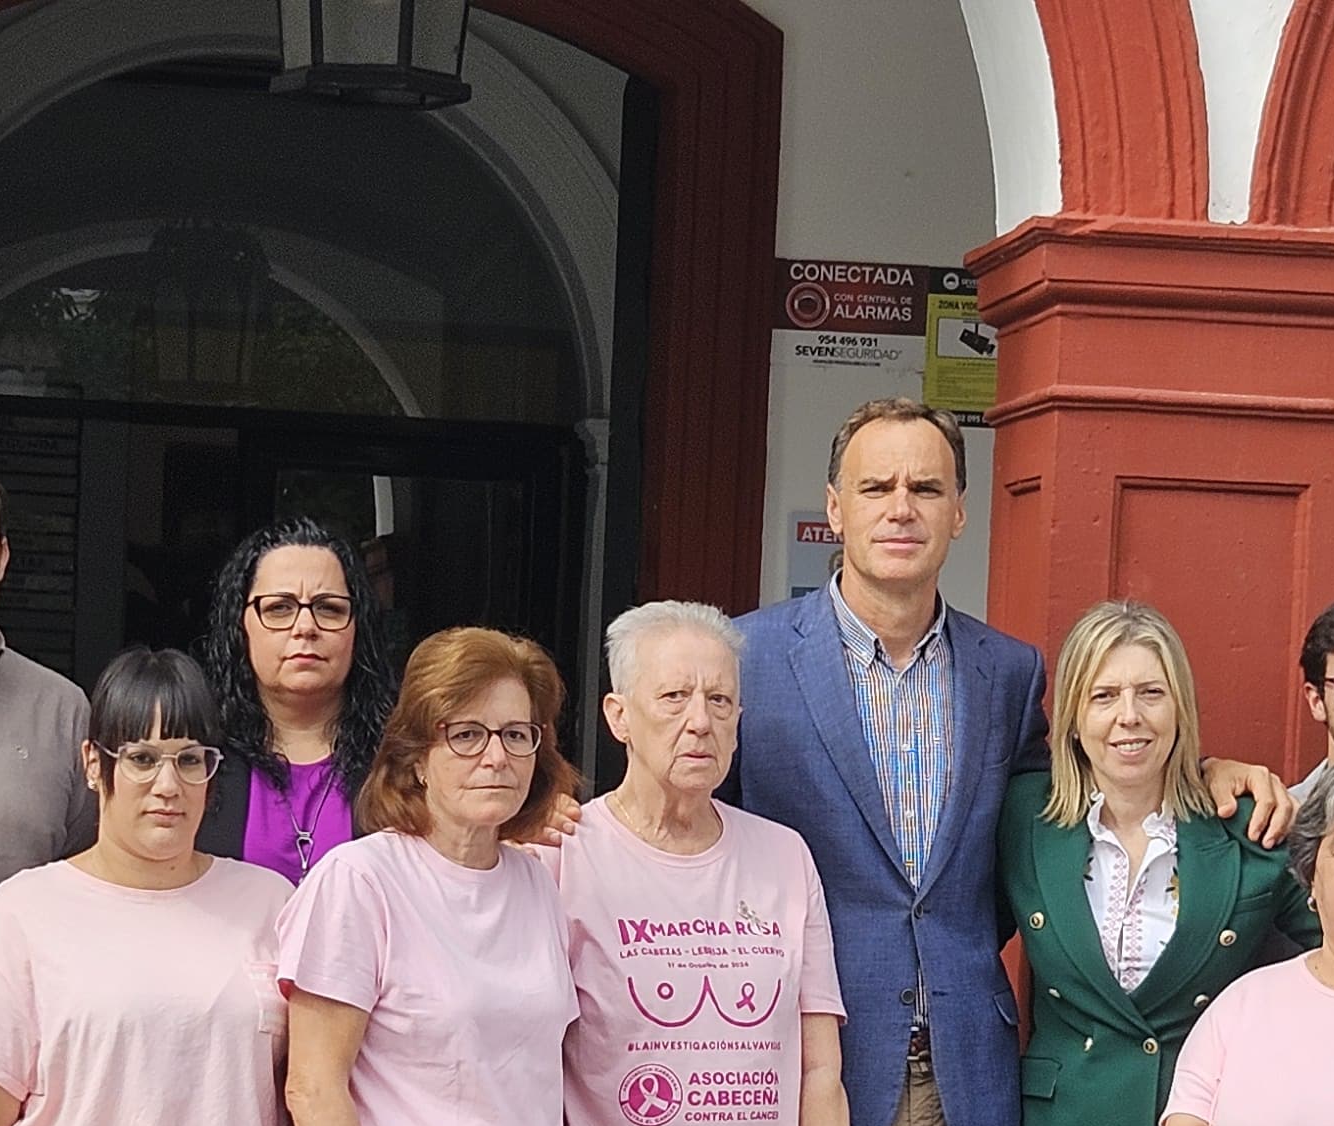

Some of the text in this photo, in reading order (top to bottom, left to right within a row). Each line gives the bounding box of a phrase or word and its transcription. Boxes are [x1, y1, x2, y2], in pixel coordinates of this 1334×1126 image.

[789, 263, 914, 286] CONECTADA
[833, 293, 913, 305] CON CENTRAL DE
[833, 304, 913, 322] ALARMAS
[817, 335, 837, 345] 954
[802, 526, 843, 543] ATEN
[617, 918, 781, 945] IX MARCHA RSA
[620, 947, 639, 959] LAS
[641, 947, 683, 956] CABEZAS
[687, 1086, 779, 1106] CABECEÑA
[684, 1111, 733, 1122] CONTRA
[736, 1111, 748, 1121] EL
